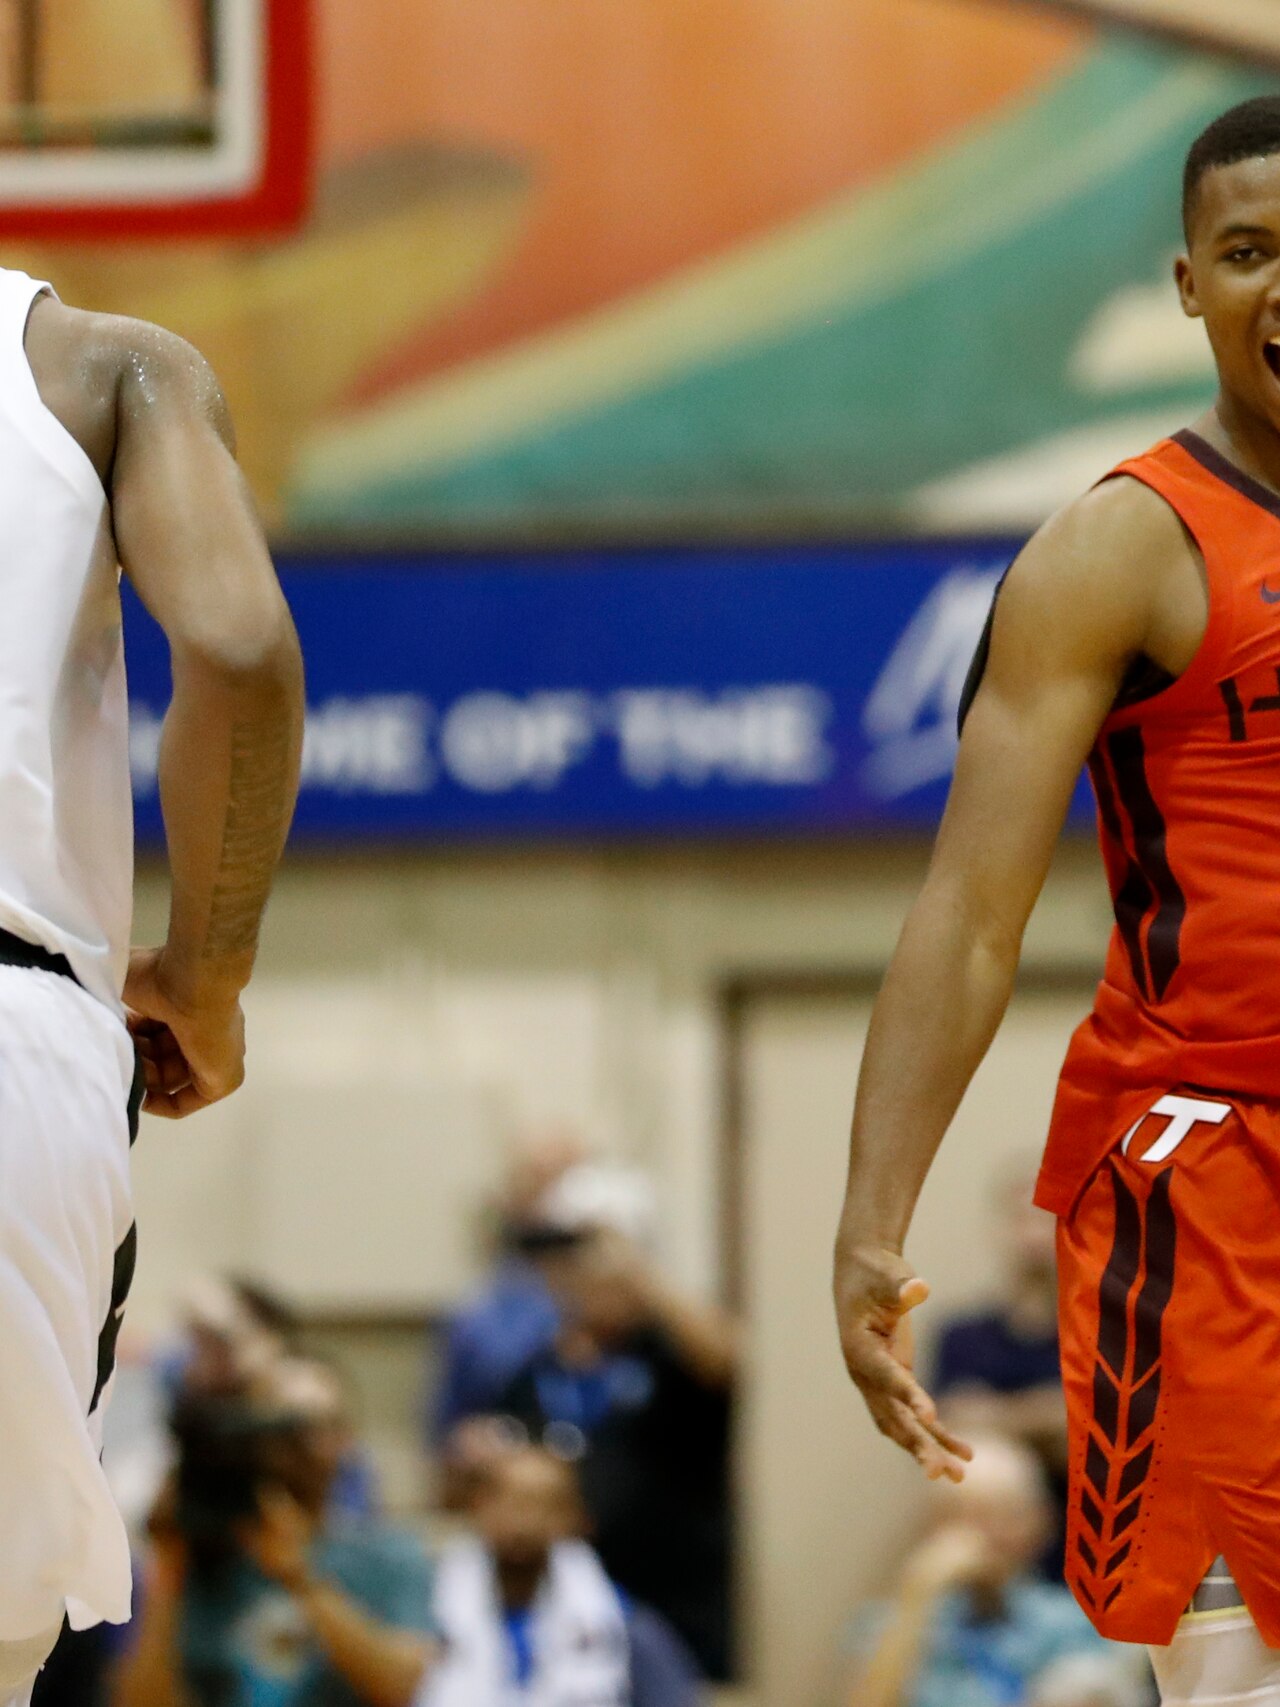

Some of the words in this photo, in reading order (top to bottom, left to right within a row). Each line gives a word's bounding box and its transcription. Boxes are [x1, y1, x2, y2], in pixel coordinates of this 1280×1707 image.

[443, 688, 592, 792] OF
[617, 682, 834, 787] THE
[1121, 1094, 1232, 1163] T
